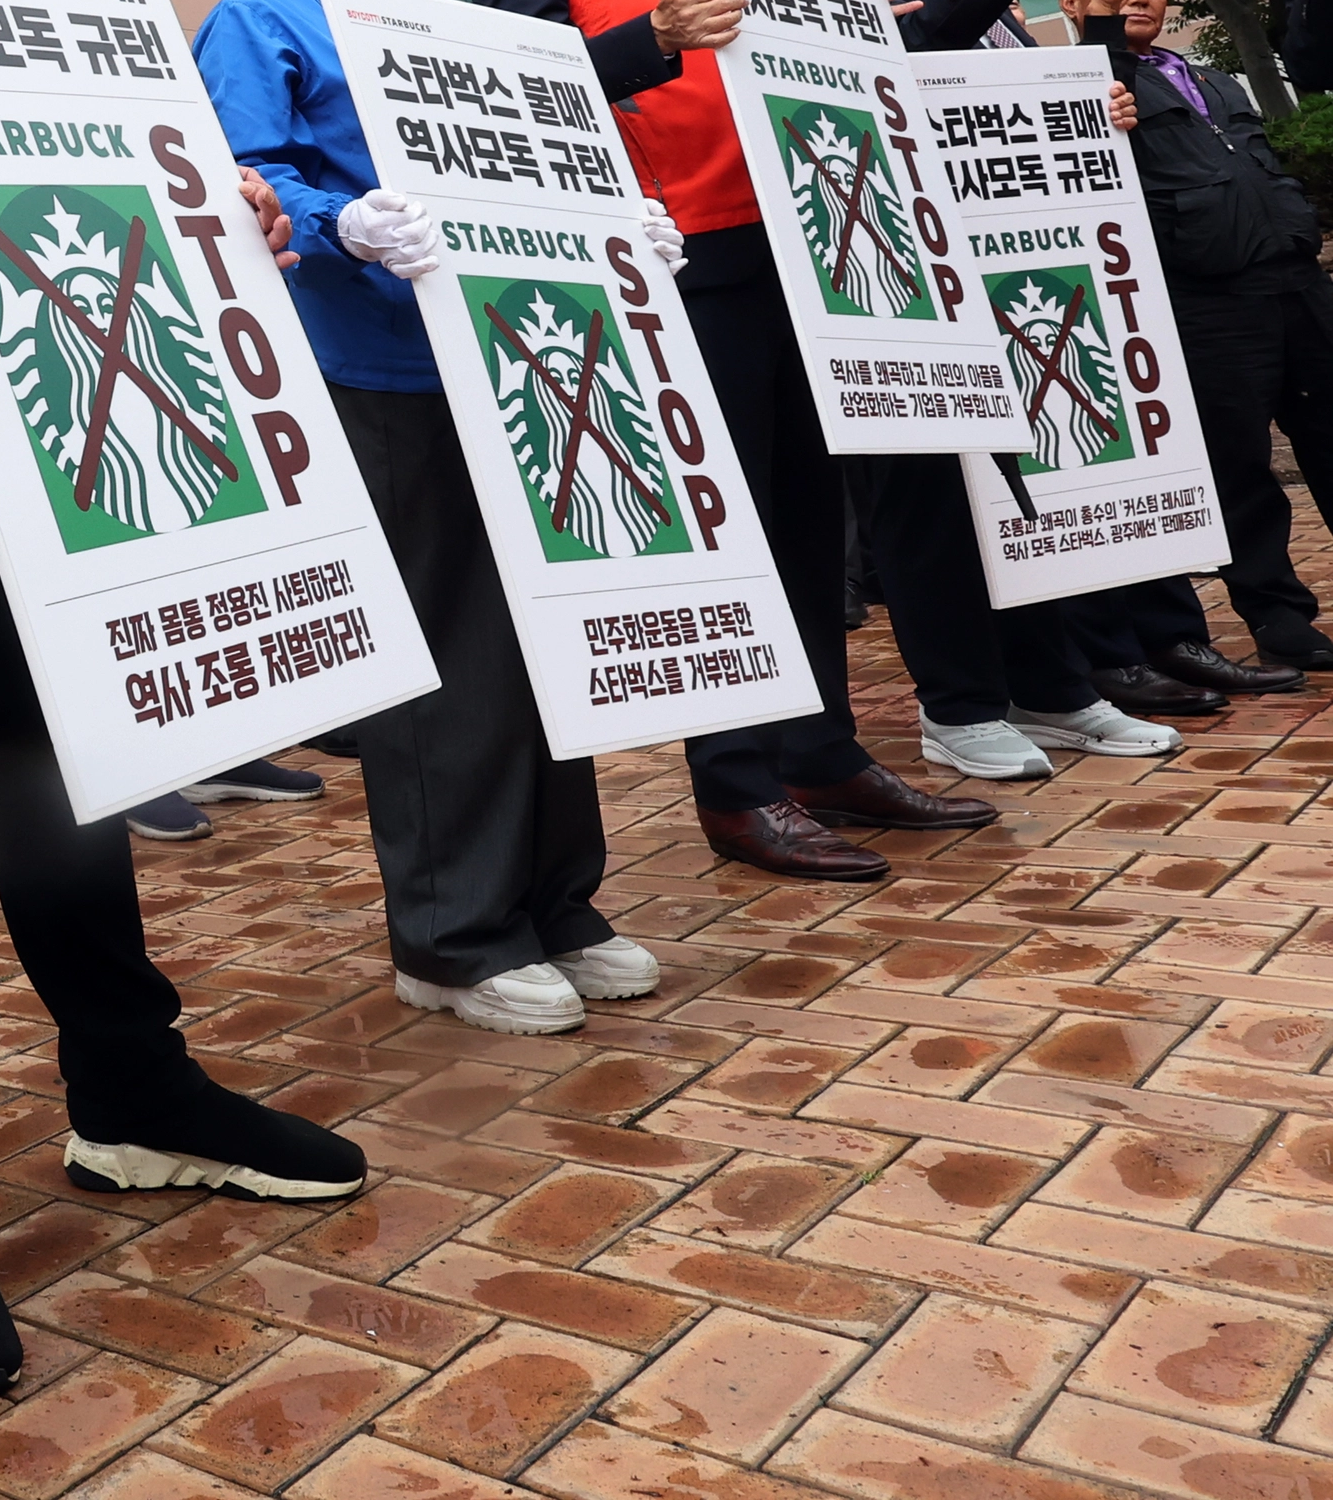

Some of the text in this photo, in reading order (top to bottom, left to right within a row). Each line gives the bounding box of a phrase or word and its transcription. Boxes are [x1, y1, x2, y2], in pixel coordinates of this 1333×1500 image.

[66, 11, 178, 81] 규탄!
[750, 50, 867, 95] STARBUCK
[377, 47, 601, 135] 스타벅스 불매!
[1040, 98, 1111, 143] 불매!
[395, 115, 626, 199] 역사모독 규탄!
[1052, 149, 1124, 195] 규탄!
[873, 74, 965, 324] STOP
[441, 219, 596, 264] STARBUCK
[967, 225, 1086, 258] TARBUCK
[148, 123, 311, 508] STOP
[1096, 220, 1172, 458] STOP
[605, 235, 728, 553] STOP
[829, 357, 1005, 389] 역사를 왜곡하고 시민의 아픔을
[839, 390, 1015, 419] 상업화하는 기업을 거부합니다!
[1002, 540, 1029, 562] 역사
[1031, 535, 1056, 558] 모독
[1039, 507, 1078, 532] 왜곡이
[105, 558, 355, 662] 진짜 몸통 정용진 사퇴하라!
[582, 601, 755, 657] 민주화운동을 모독한
[124, 606, 377, 729] 역사 조롱 처벌하라!
[588, 643, 780, 707] 스타벅스를 거부합니다!
